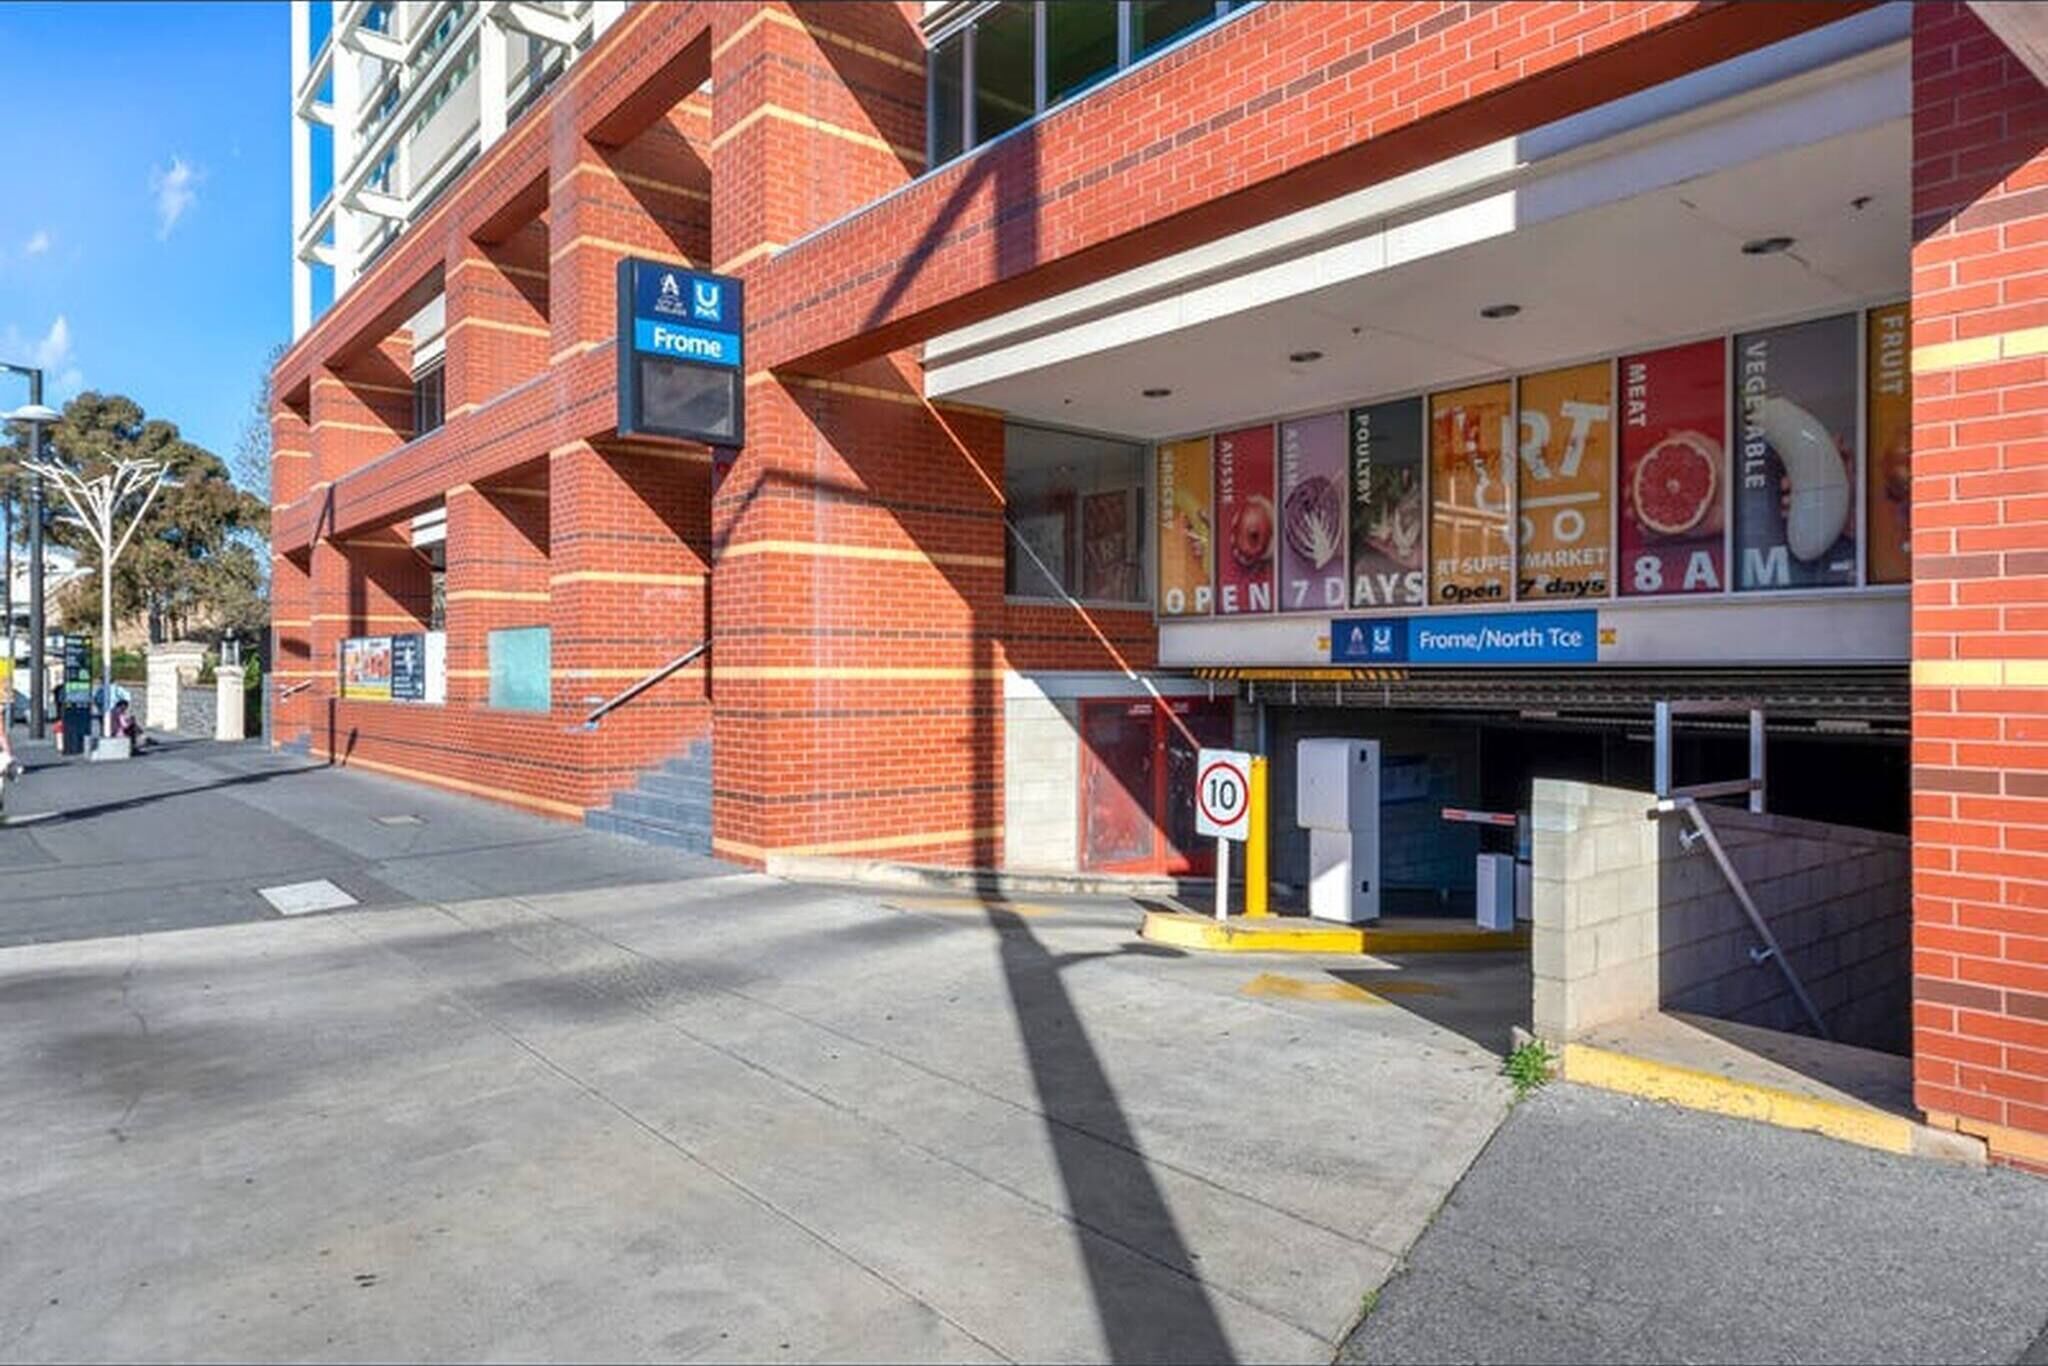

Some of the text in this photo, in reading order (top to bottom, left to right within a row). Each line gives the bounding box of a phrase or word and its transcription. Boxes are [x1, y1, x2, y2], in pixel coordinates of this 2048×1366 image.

[654, 326, 723, 359] Frome
[1881, 314, 1905, 394] FRUIT
[1626, 363, 1648, 427] MEAT
[1743, 338, 1769, 489] VEGETABLE
[1219, 440, 1235, 504] AUSSIE
[1356, 414, 1371, 504] POULTRY
[1463, 547, 1609, 574] SUPEMARKET
[1634, 555, 1664, 592] 8
[1165, 571, 1425, 614] OPEN 7 DAYS
[1440, 583, 1502, 601] Open
[1545, 577, 1606, 597] days
[1419, 627, 1583, 652] Frome/North Tce
[1209, 779, 1238, 811] 10
